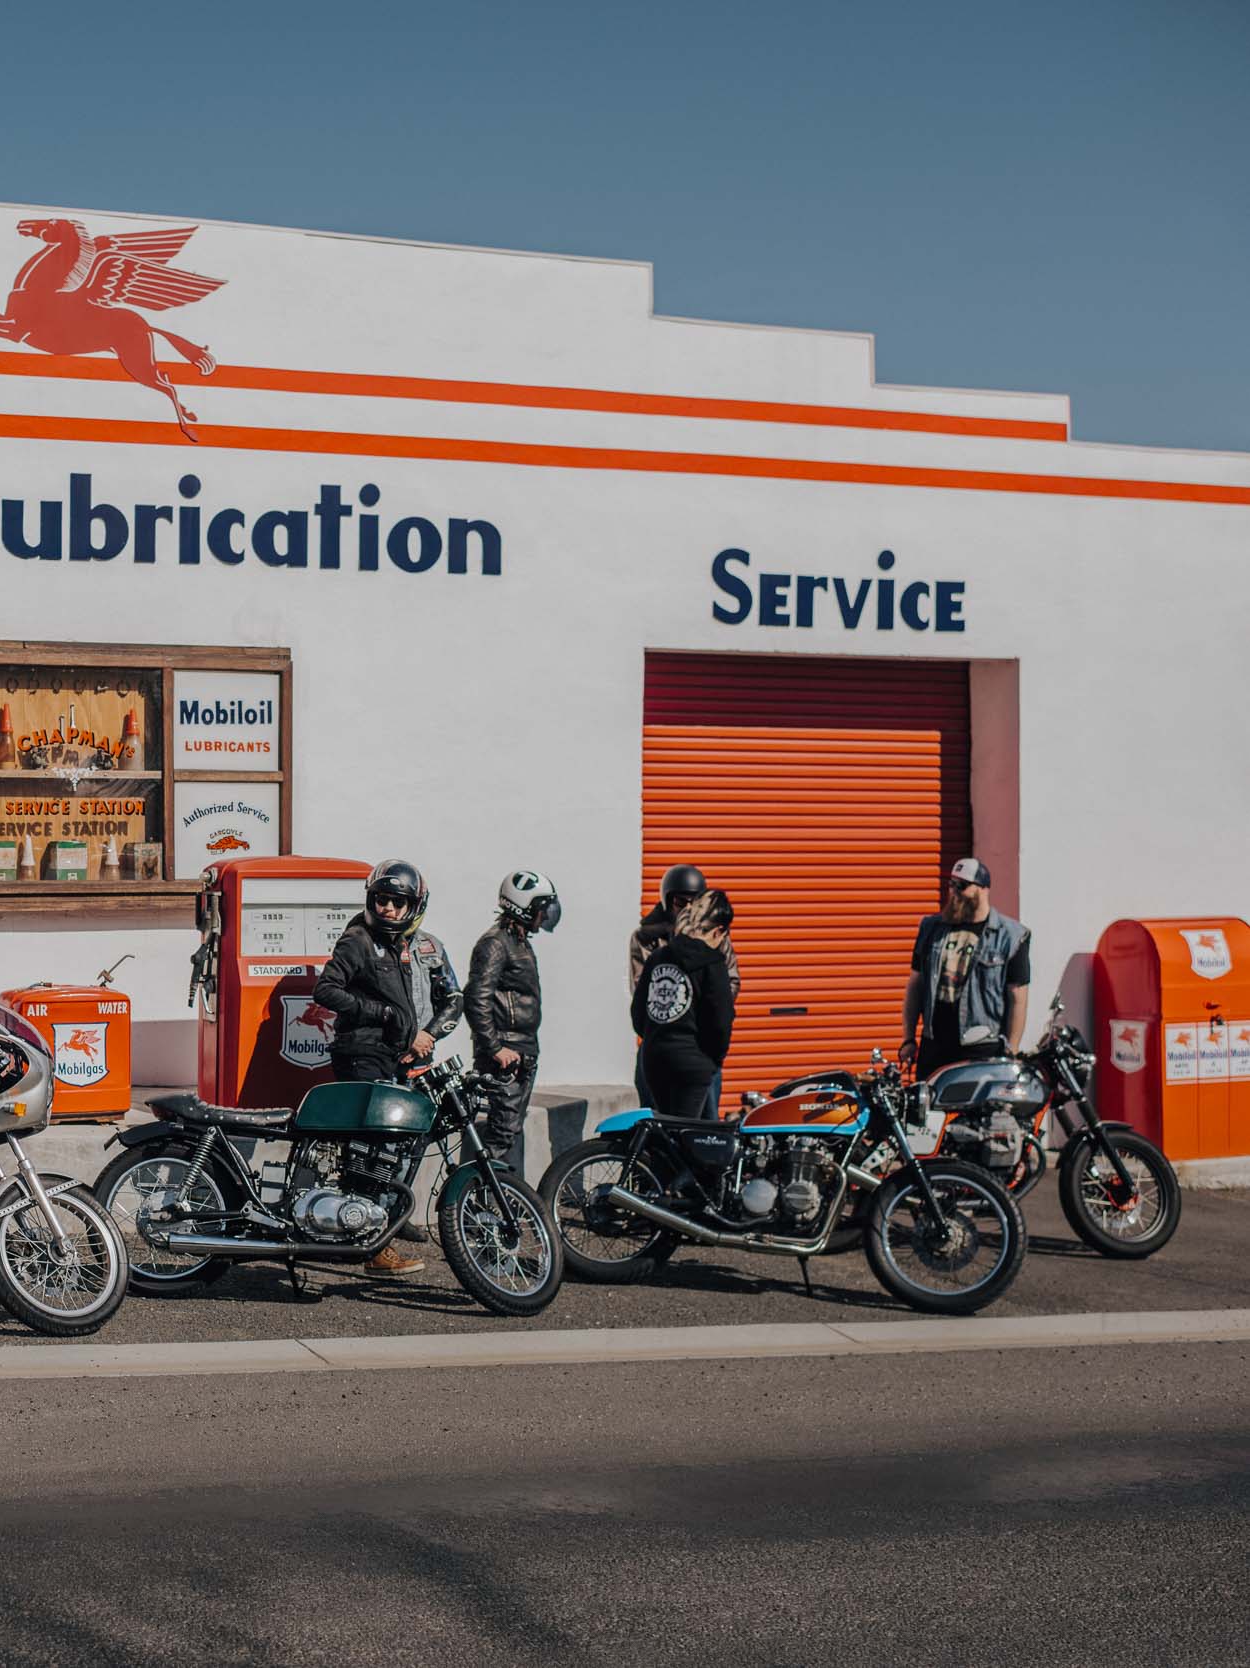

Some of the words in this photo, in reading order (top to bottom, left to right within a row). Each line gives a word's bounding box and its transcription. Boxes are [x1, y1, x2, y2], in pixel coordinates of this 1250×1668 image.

[179, 700, 272, 725] Mobiloil
[185, 741, 271, 752] LUBRICANTS
[6, 800, 70, 815] SERVICE
[79, 800, 146, 816] STATION
[182, 802, 234, 828] Authorized
[237, 802, 270, 824] Service
[210, 828, 243, 840] GARGOYLE
[253, 966, 303, 976] STANDARD
[27, 1004, 48, 1016] AIR
[97, 1002, 128, 1014] WATER
[288, 1039, 332, 1057] Mobilga
[57, 1062, 104, 1077] Mobilgas
